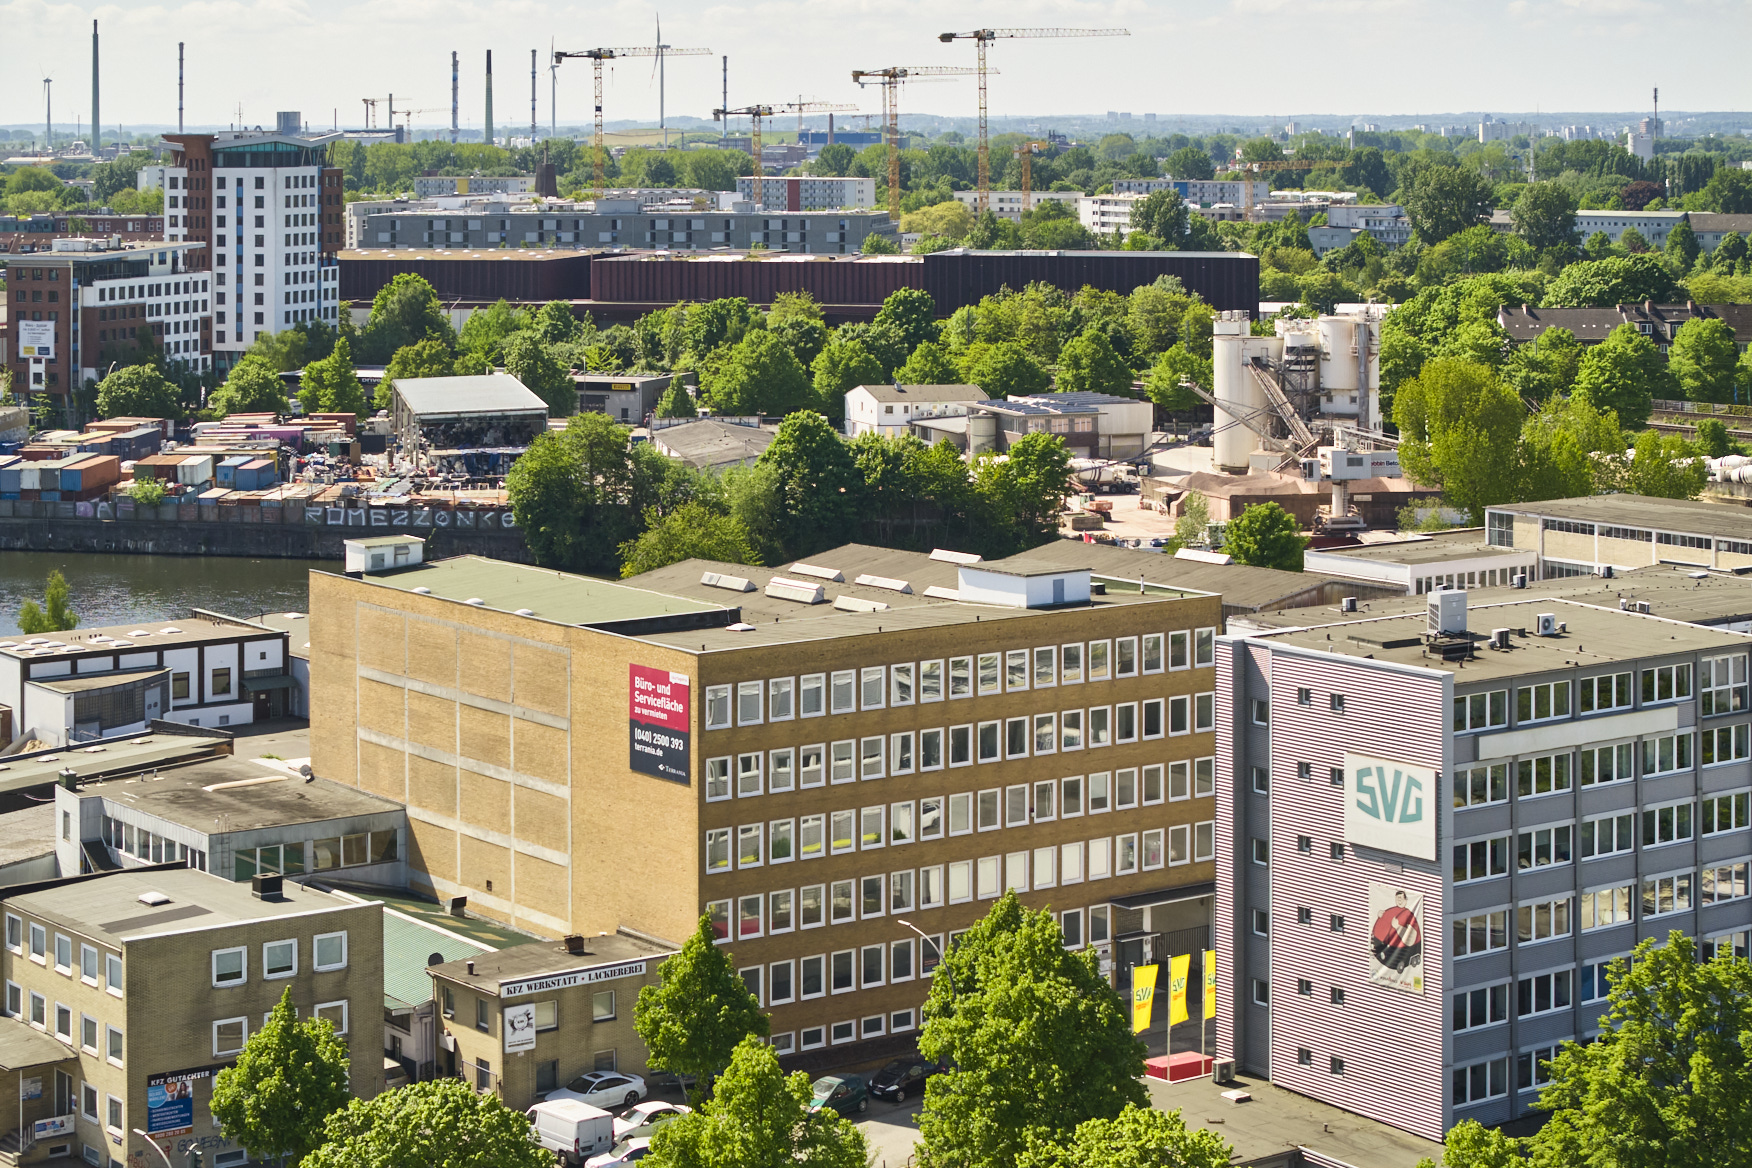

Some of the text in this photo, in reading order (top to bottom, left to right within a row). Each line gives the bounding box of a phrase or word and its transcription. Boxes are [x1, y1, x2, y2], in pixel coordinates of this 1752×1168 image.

[634, 676, 656, 692] Büro-
[656, 683, 671, 696] und
[634, 690, 684, 713] Servicefläche
[634, 706, 668, 720] zu vermieten
[634, 727, 684, 751] (040) 2500 393
[634, 742, 664, 757] terrania.de
[1356, 766, 1423, 824] SVG
[506, 964, 643, 996] KFZ WERKSTATT LACKIEREREI
[151, 1070, 210, 1086] KFZ GUTACHTER
